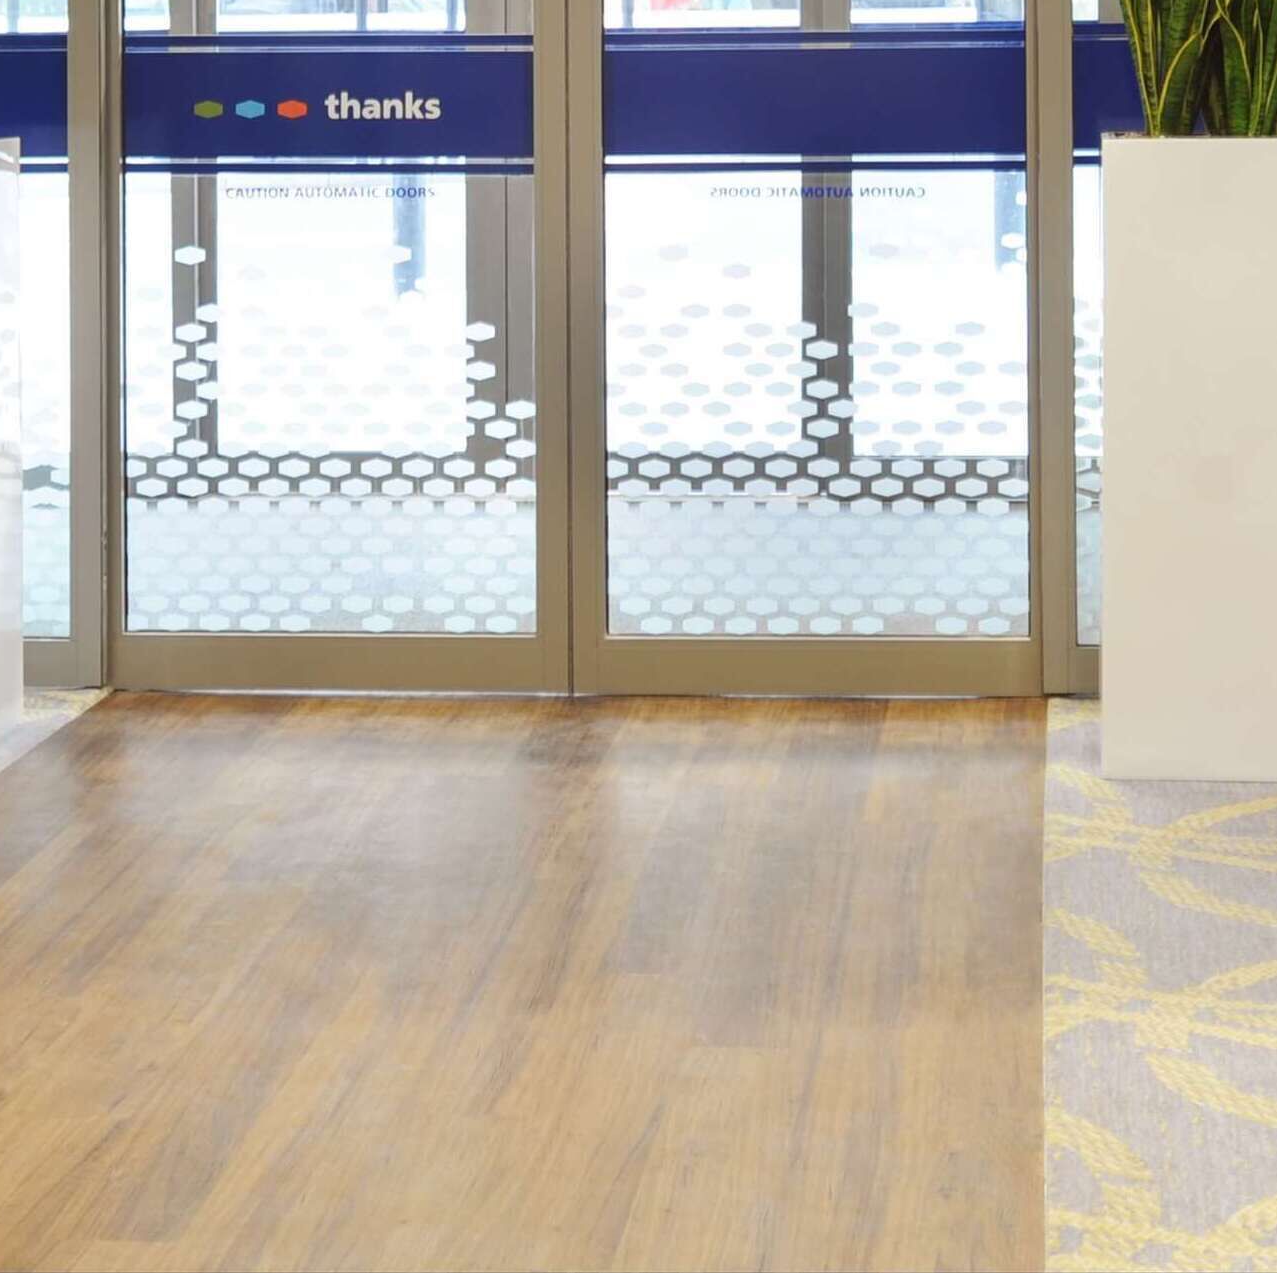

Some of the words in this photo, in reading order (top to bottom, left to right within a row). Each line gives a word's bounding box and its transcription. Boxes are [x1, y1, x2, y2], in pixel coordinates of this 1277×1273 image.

[324, 91, 441, 119] thanks
[225, 187, 290, 199] CAUTION
[293, 187, 380, 199] AUTOMATIC
[385, 187, 436, 199] DOORS
